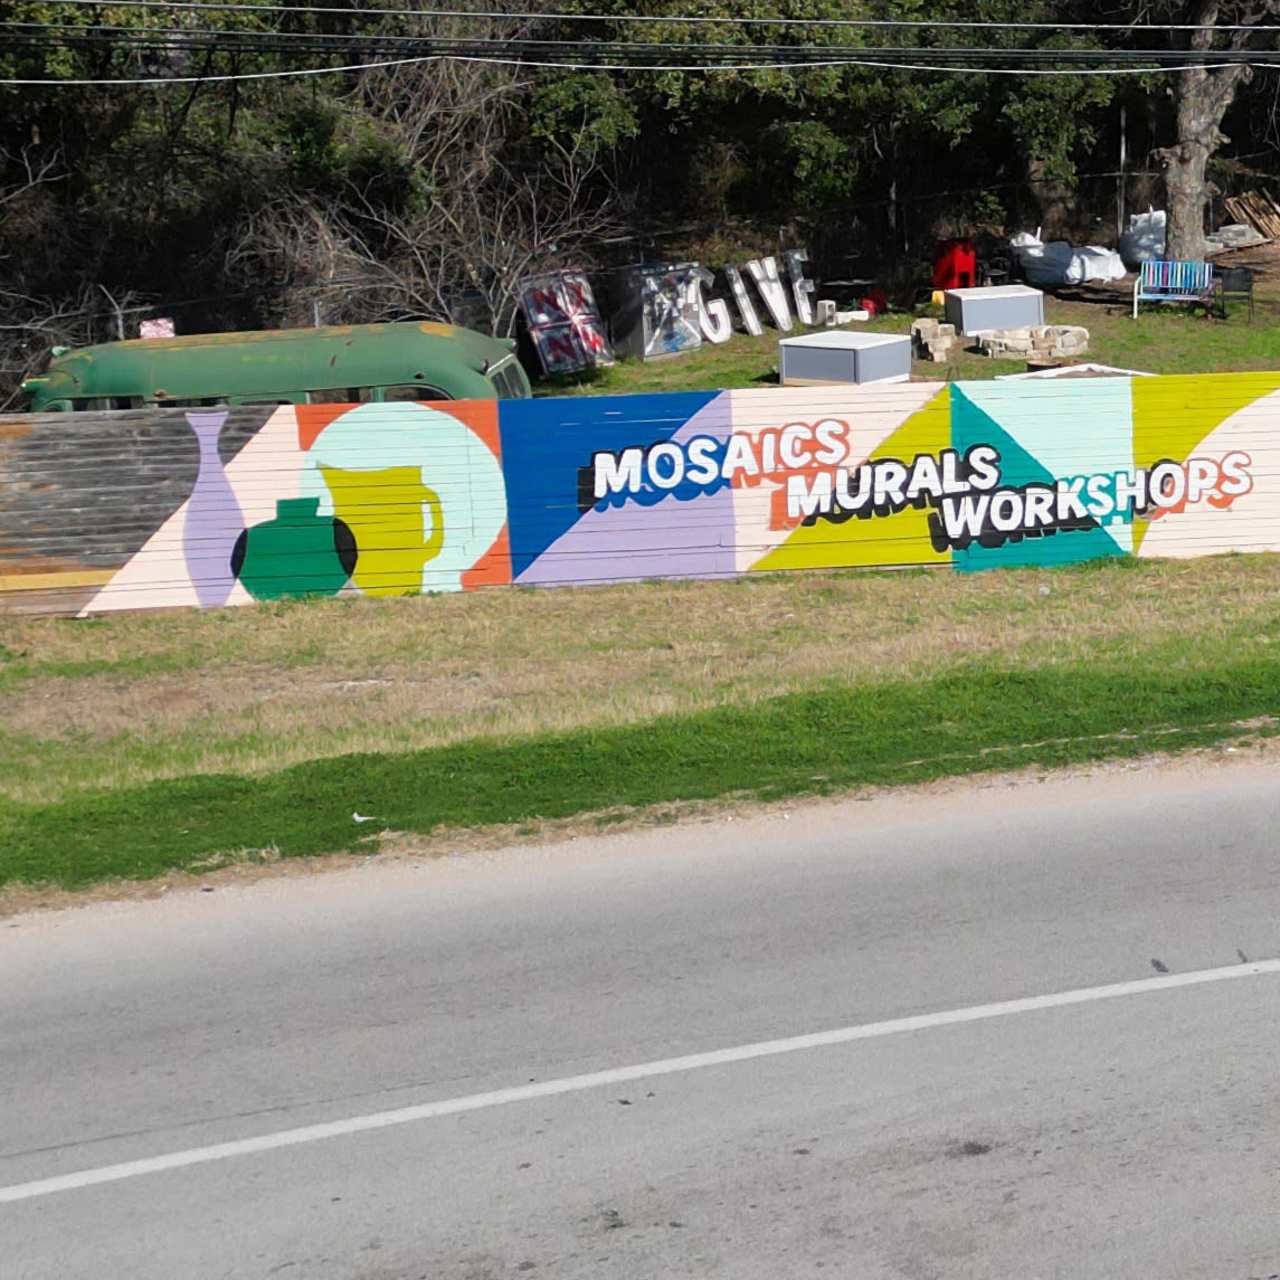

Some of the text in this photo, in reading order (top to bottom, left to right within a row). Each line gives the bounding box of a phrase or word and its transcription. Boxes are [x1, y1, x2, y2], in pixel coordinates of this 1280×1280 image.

[593, 419, 846, 499] MOSAICS
[786, 445, 999, 518] MURALS
[940, 452, 1252, 540] WORKSHOPS
